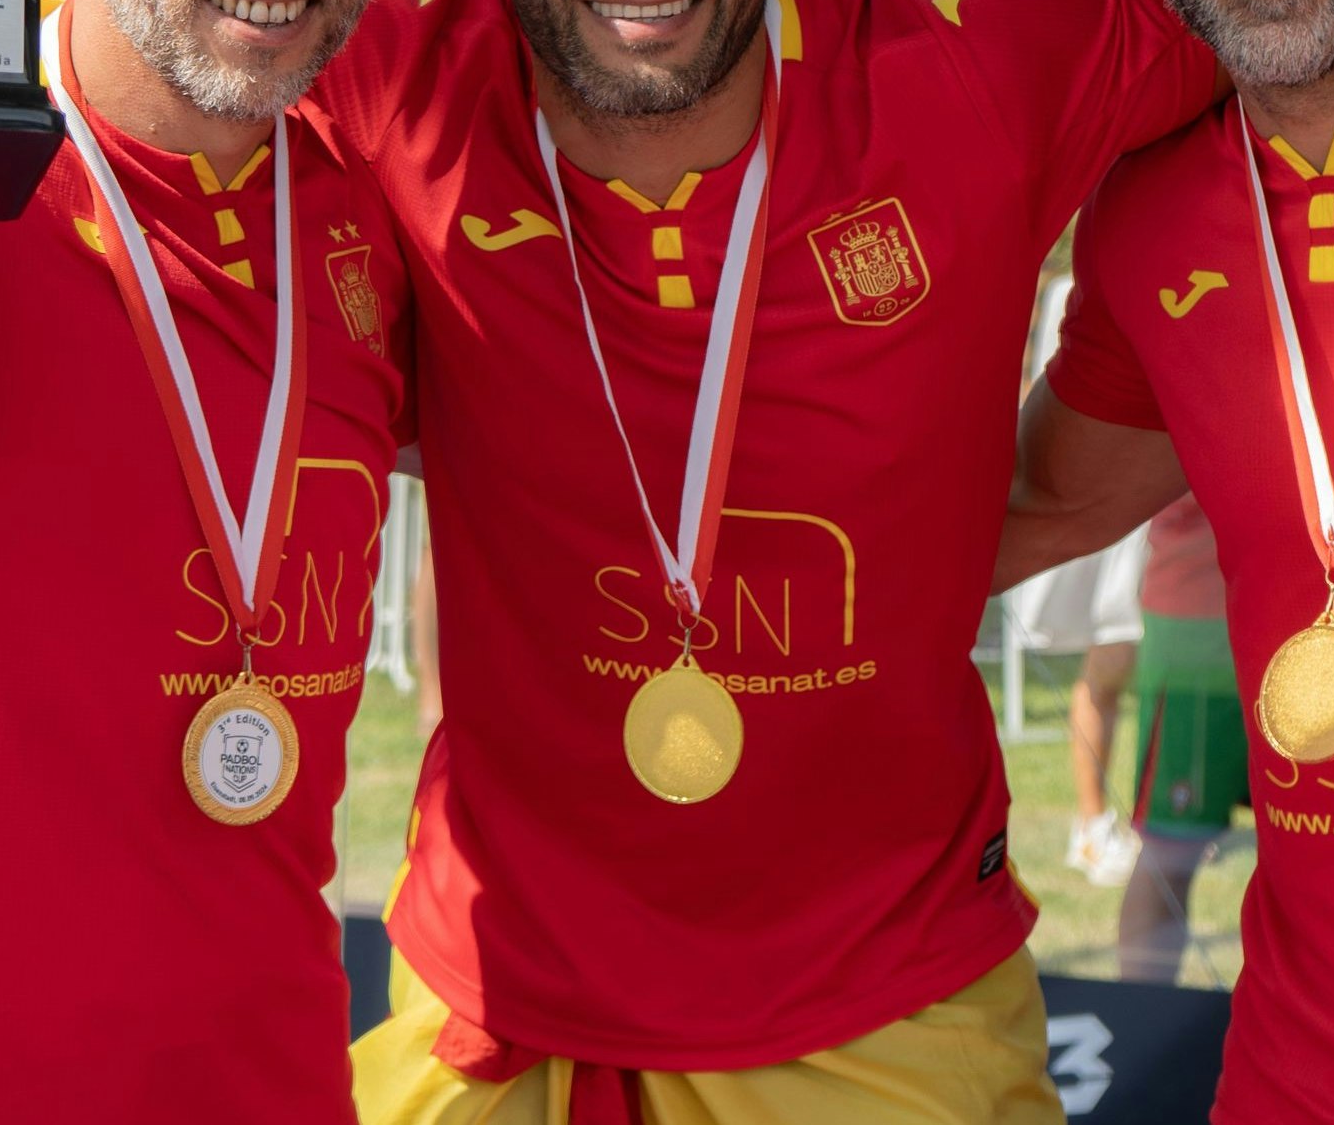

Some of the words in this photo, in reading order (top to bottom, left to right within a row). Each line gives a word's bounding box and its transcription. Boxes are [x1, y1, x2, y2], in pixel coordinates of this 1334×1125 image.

[159, 661, 363, 698] wwwsosanat.es
[235, 713, 271, 737] Edition
[220, 753, 263, 766] PADBOL
